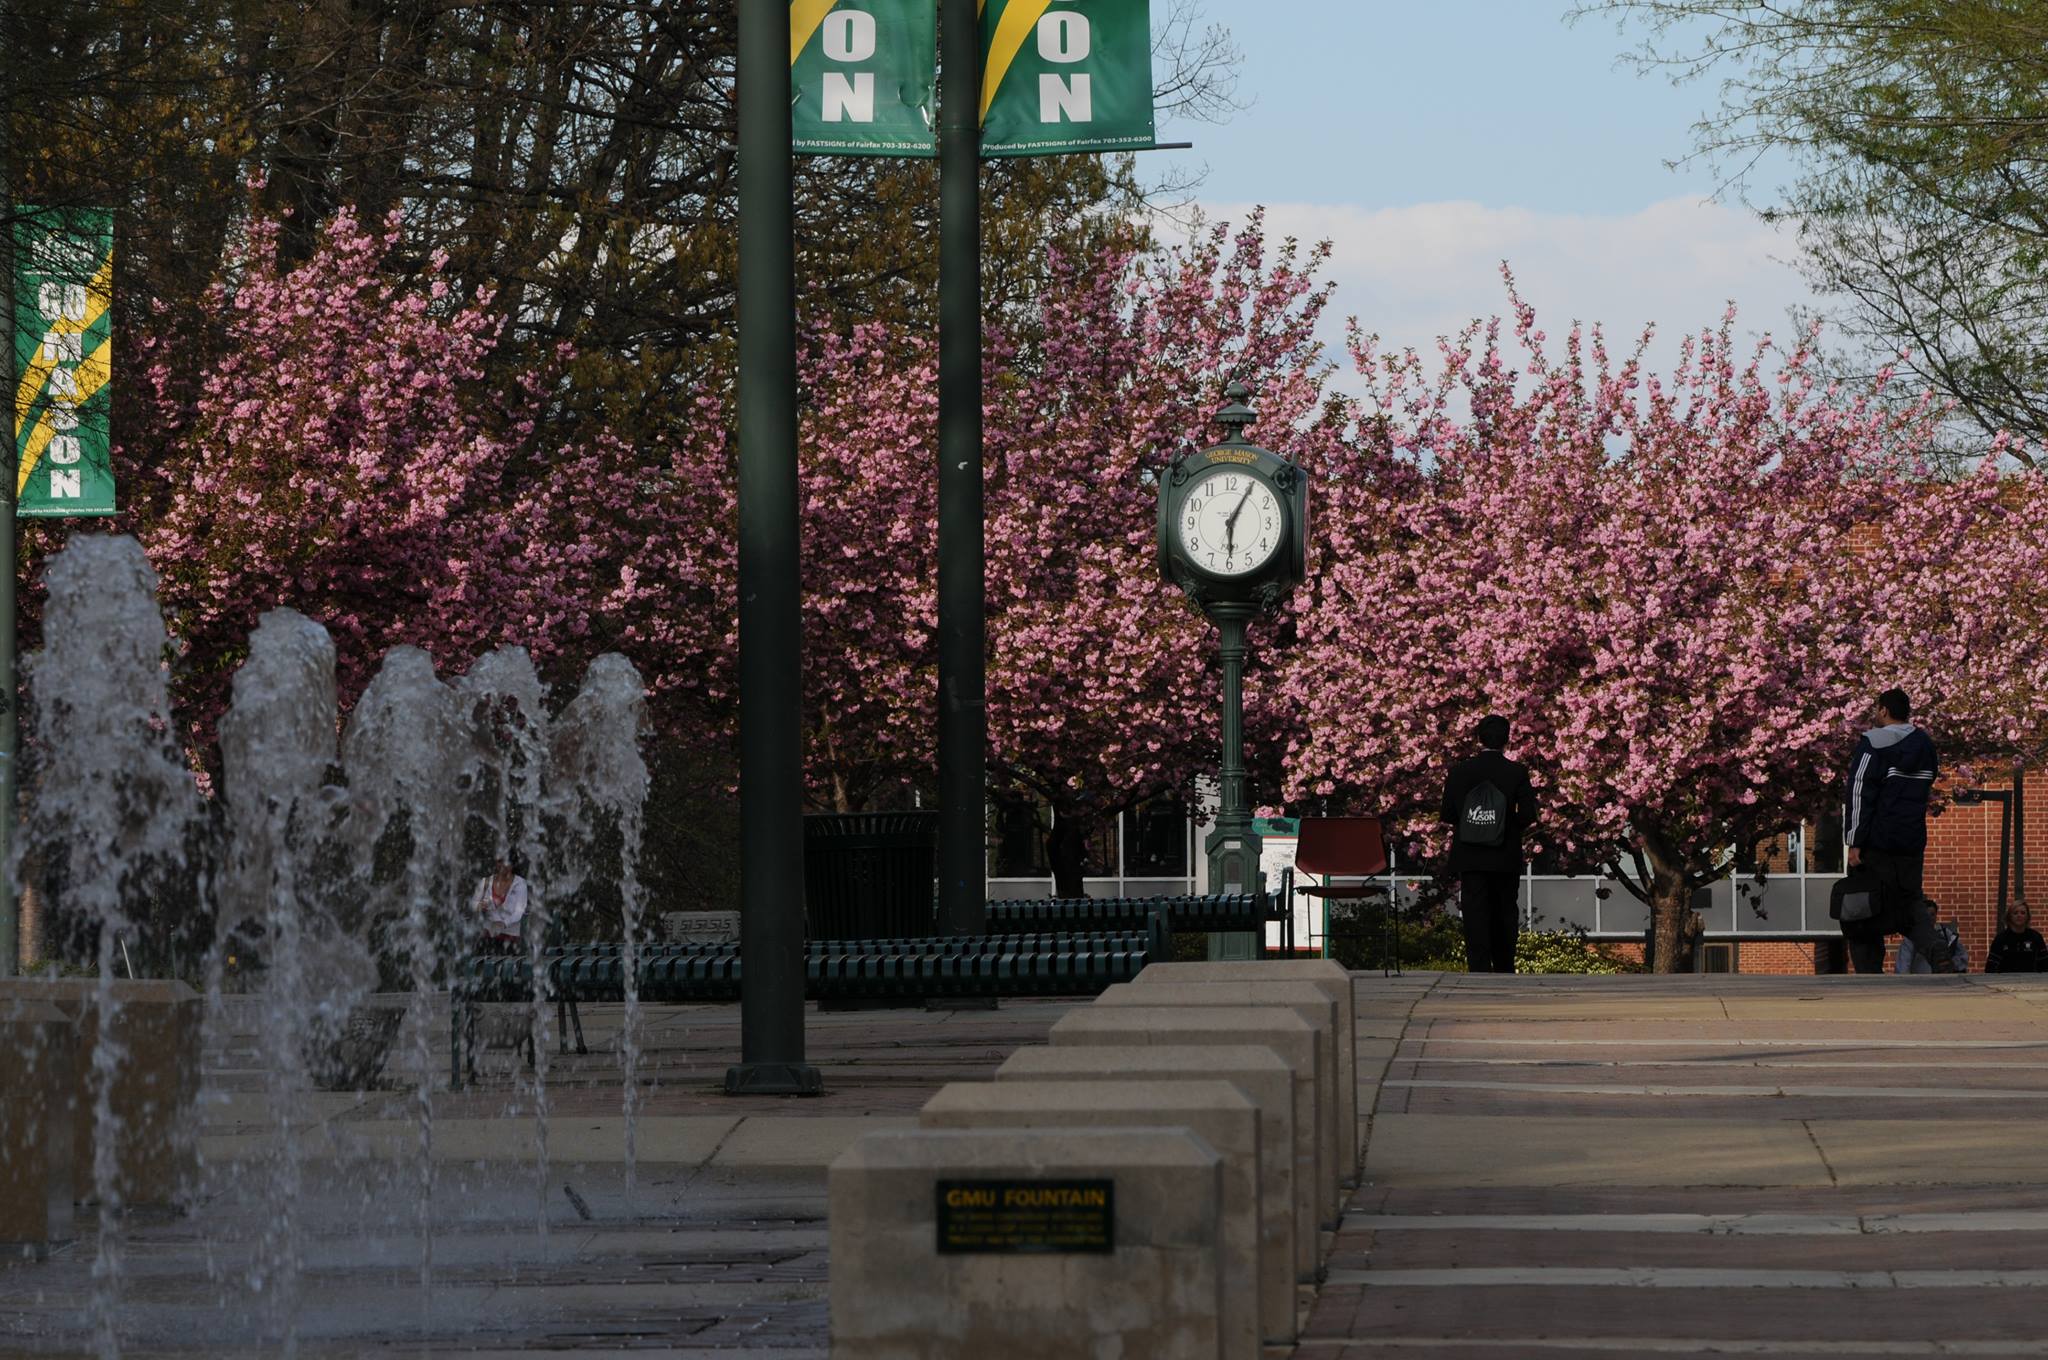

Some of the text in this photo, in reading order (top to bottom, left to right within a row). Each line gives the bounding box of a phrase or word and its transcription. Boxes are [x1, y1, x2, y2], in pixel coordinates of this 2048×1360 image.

[796, 139, 806, 147] by
[807, 140, 846, 148] FASTSIGNS
[882, 142, 931, 150] 703-352-6200
[982, 143, 1016, 151] Produced
[1017, 143, 1027, 151] by
[1027, 141, 1067, 149] FASTSIGNS
[1076, 138, 1101, 146] Fairfax
[39, 282, 86, 322] GO
[1211, 456, 1251, 464] UNIVERSITY
[1205, 482, 1214, 497] 11
[1225, 477, 1238, 491] 12
[1190, 498, 1202, 512] 10
[1263, 496, 1270, 510] 2
[1187, 516, 1195, 530] 9
[1265, 516, 1272, 531] 3
[1190, 537, 1199, 551] 8
[1260, 537, 1267, 551] 4
[1207, 552, 1215, 567] 7
[1225, 556, 1233, 570] 6
[1245, 552, 1253, 566] 5
[947, 1188, 1105, 1207] GMU FOUNTAIN
